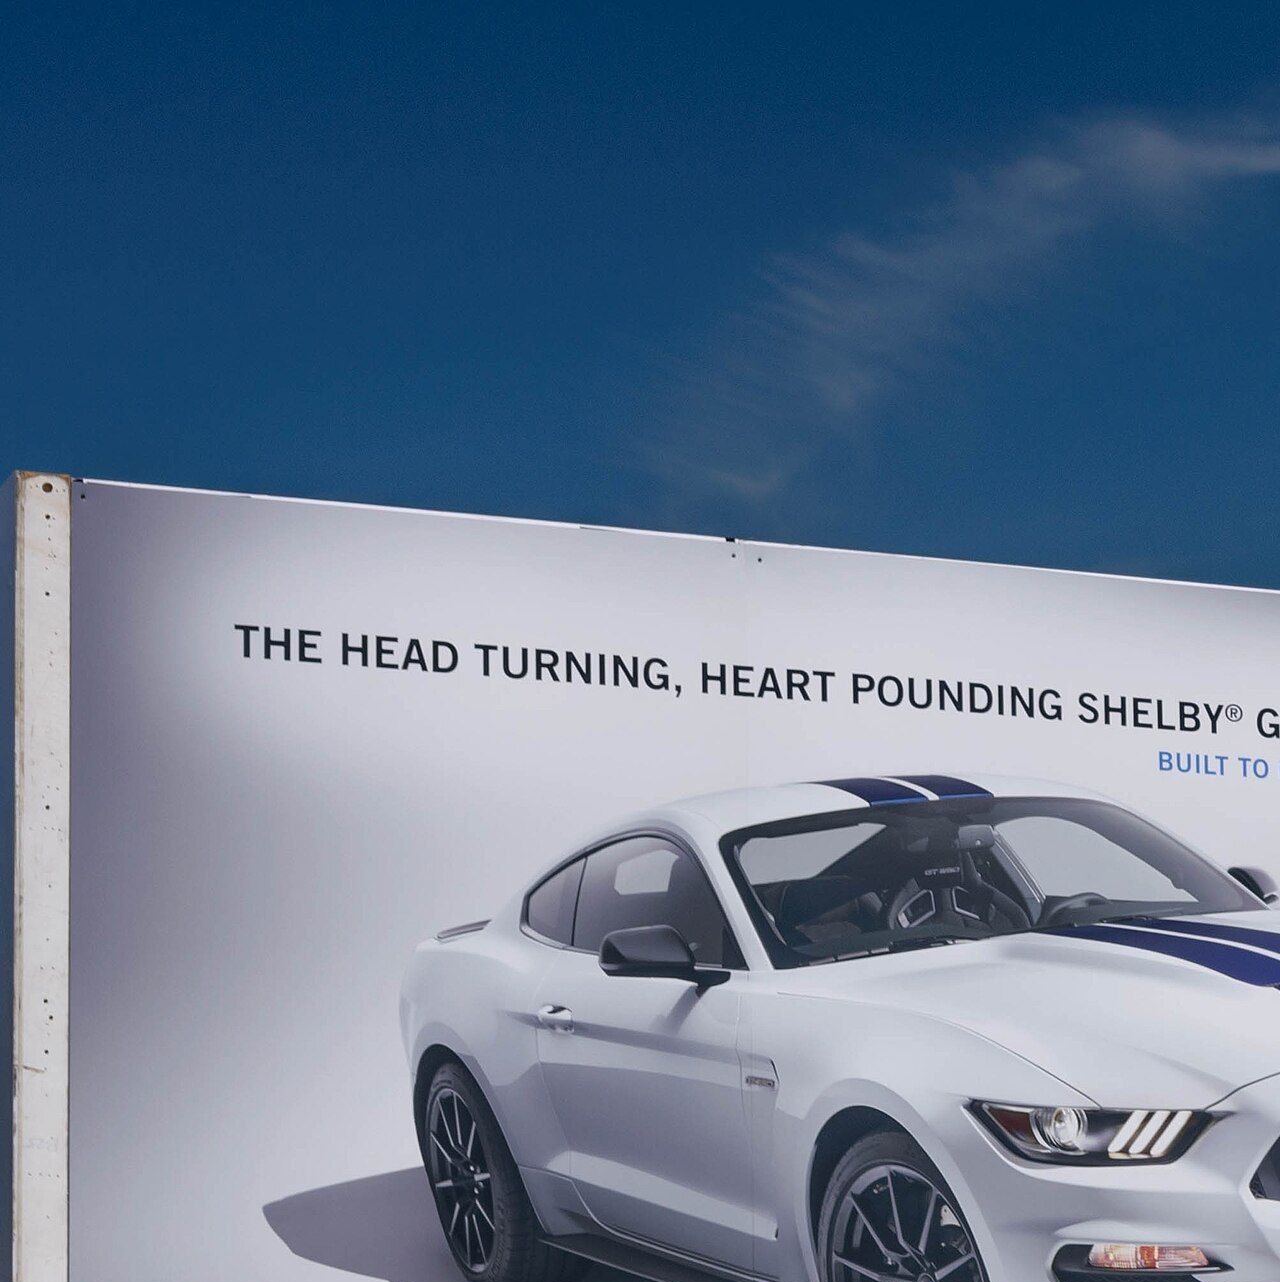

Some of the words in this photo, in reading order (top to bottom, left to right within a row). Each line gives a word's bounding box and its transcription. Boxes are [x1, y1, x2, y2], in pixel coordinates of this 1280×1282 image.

[234, 623, 323, 664] THE
[341, 632, 459, 674] HEAD
[473, 643, 682, 699] TURNING,
[701, 661, 836, 703] HEART
[851, 672, 1063, 721] POUNDING
[1157, 750, 1229, 776] BUILT
[1238, 756, 1269, 779] TO
